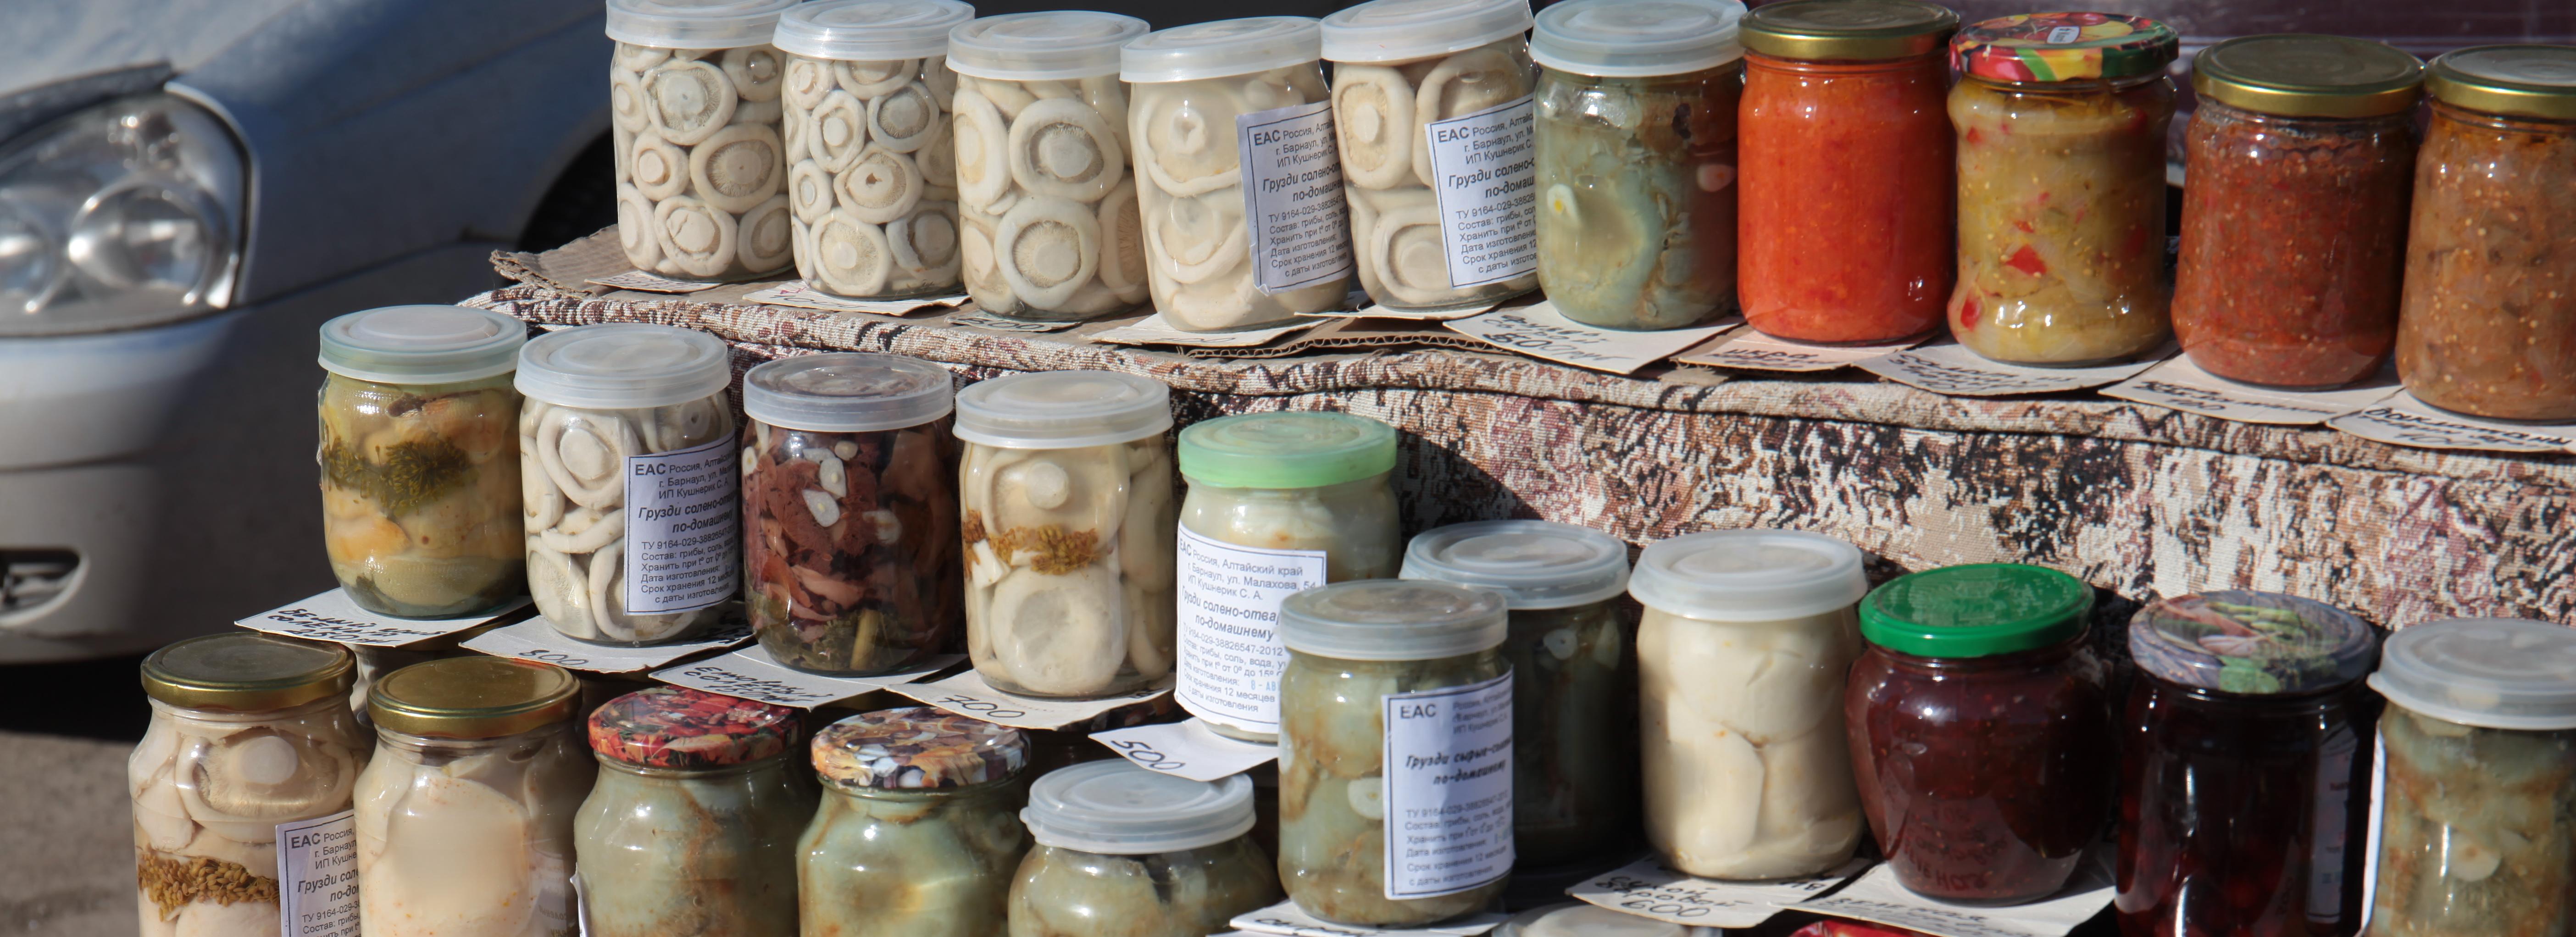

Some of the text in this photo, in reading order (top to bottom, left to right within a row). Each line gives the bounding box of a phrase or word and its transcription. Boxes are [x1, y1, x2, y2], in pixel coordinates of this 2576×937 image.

[1283, 127, 1314, 140] Россия,
[1472, 122, 1508, 136] Россия,
[1283, 140, 1319, 153] Барнаул,
[1473, 135, 1514, 150] Барнаул,
[1277, 156, 1290, 168] ИП
[1293, 149, 1327, 165] Кушнерик
[1466, 153, 1482, 164] ИП
[1484, 143, 1525, 161] Кушнерик
[1263, 173, 1298, 193] Грузди
[1449, 169, 1491, 189] Грузди
[1268, 211, 1280, 222] ТУ
[1455, 209, 1469, 219] ТУ
[1458, 218, 1493, 230] Состав:
[1497, 211, 1523, 224] грибы,
[1270, 222, 1299, 234] Состав:
[1302, 216, 1324, 229] грибы,
[1270, 233, 1303, 246] Хранить
[1305, 228, 1317, 238] при
[1459, 229, 1498, 243] Хранить
[1501, 224, 1515, 234] при
[1271, 248, 1290, 258] Дата
[1271, 244, 1335, 269] Срок хранения 12
[1461, 244, 1483, 255] Дата
[1463, 255, 1486, 265] Срок
[1488, 244, 1527, 260] хранения
[1291, 265, 1310, 277] даты
[1486, 261, 1508, 273] даты
[669, 463, 702, 473] Россия,
[668, 475, 706, 487] Барнаул,
[659, 489, 674, 499] ИП
[677, 483, 716, 499] Кушнерик
[638, 505, 681, 521] Грузди
[680, 548, 705, 559] грибы,
[707, 544, 723, 553] соль,
[641, 563, 679, 573] Хранить
[682, 560, 696, 570] при
[1193, 549, 1303, 577] Россия, Алтайский край
[641, 574, 663, 583] Дата
[666, 566, 720, 581] изготовления:
[1192, 562, 1224, 582] Барнаул,
[1227, 576, 1240, 584] ул.
[1244, 577, 1299, 591] Малахова,
[641, 576, 716, 594] Срок хранения 12
[662, 594, 684, 604] даты
[688, 582, 729, 599] изготовления
[1188, 573, 1263, 600] ИП Кушнерик С. А.
[1195, 615, 1274, 642] по-домашнему
[1224, 654, 1247, 665] соль,
[1249, 658, 1274, 668] вода,
[1205, 694, 1259, 712] изготовления
[1224, 688, 1234, 697] 12
[1236, 691, 1275, 703] месяцев
[937, 694, 1025, 718] 700
[1110, 740, 1187, 770] 500
[1406, 753, 1449, 770] Грузди
[323, 828, 355, 843] Россия,
[1405, 848, 1429, 858] Дата
[315, 858, 330, 870] ИП
[1407, 863, 1431, 872] Срок
[298, 874, 337, 894] Грузди
[1621, 899, 1710, 917] 600
[302, 913, 315, 923] ТУ
[303, 920, 335, 934] Состав:
